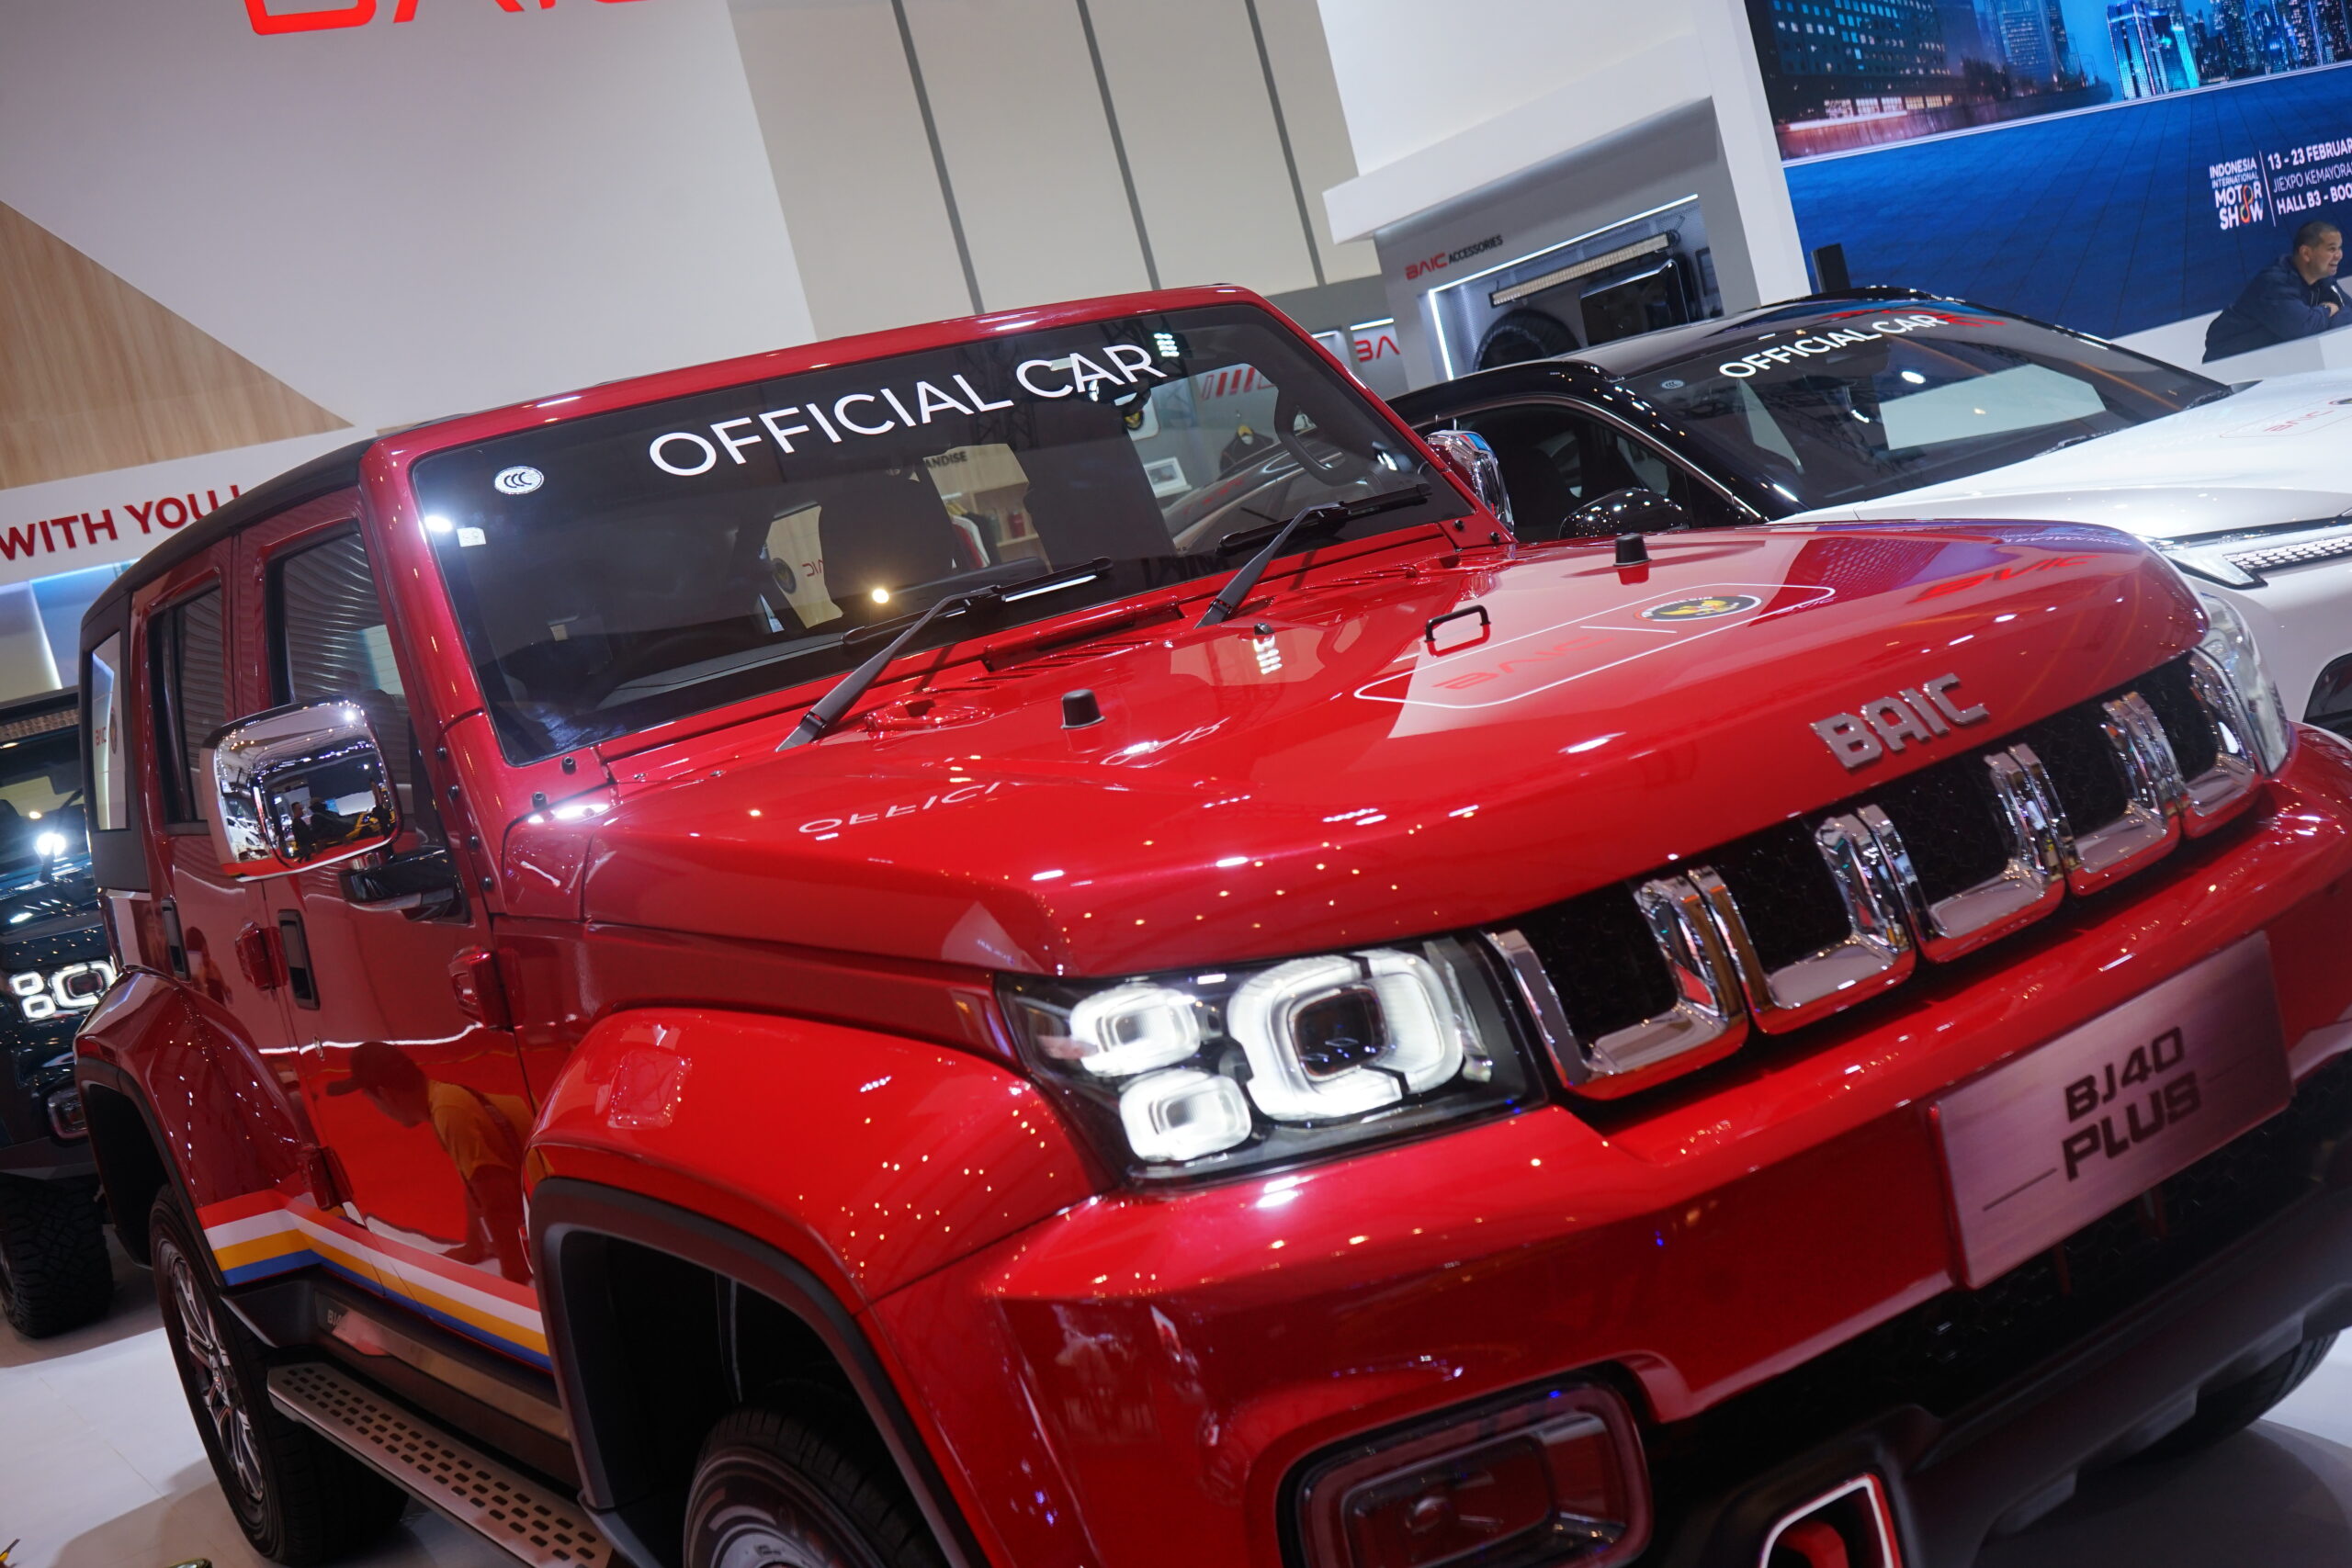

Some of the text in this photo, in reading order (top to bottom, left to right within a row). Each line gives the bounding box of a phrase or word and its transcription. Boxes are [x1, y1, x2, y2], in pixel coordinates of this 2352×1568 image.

[2209, 156, 2257, 179] INDONESIA
[2211, 171, 2259, 189] INTERNATIONAL
[2267, 152, 2282, 171] 13
[2290, 146, 2306, 166] 23
[2273, 161, 2352, 193] JIEXPO KEMAYORA
[2214, 180, 2263, 209] MOTOR
[2219, 201, 2264, 231] SHOW
[2276, 193, 2306, 215] HALL
[2306, 189, 2322, 209] B3
[1405, 234, 1503, 280] BAIC ACCESSORIES
[1719, 314, 1950, 378] OFFICIAL CAR
[650, 344, 1167, 477] OFFICIAL CAR
[0, 509, 119, 560] WITH
[1430, 636, 1617, 690] BAIC
[1809, 672, 1990, 771] BAIC
[2064, 1026, 2185, 1123] BJ40
[2062, 1071, 2201, 1182] PLUS
